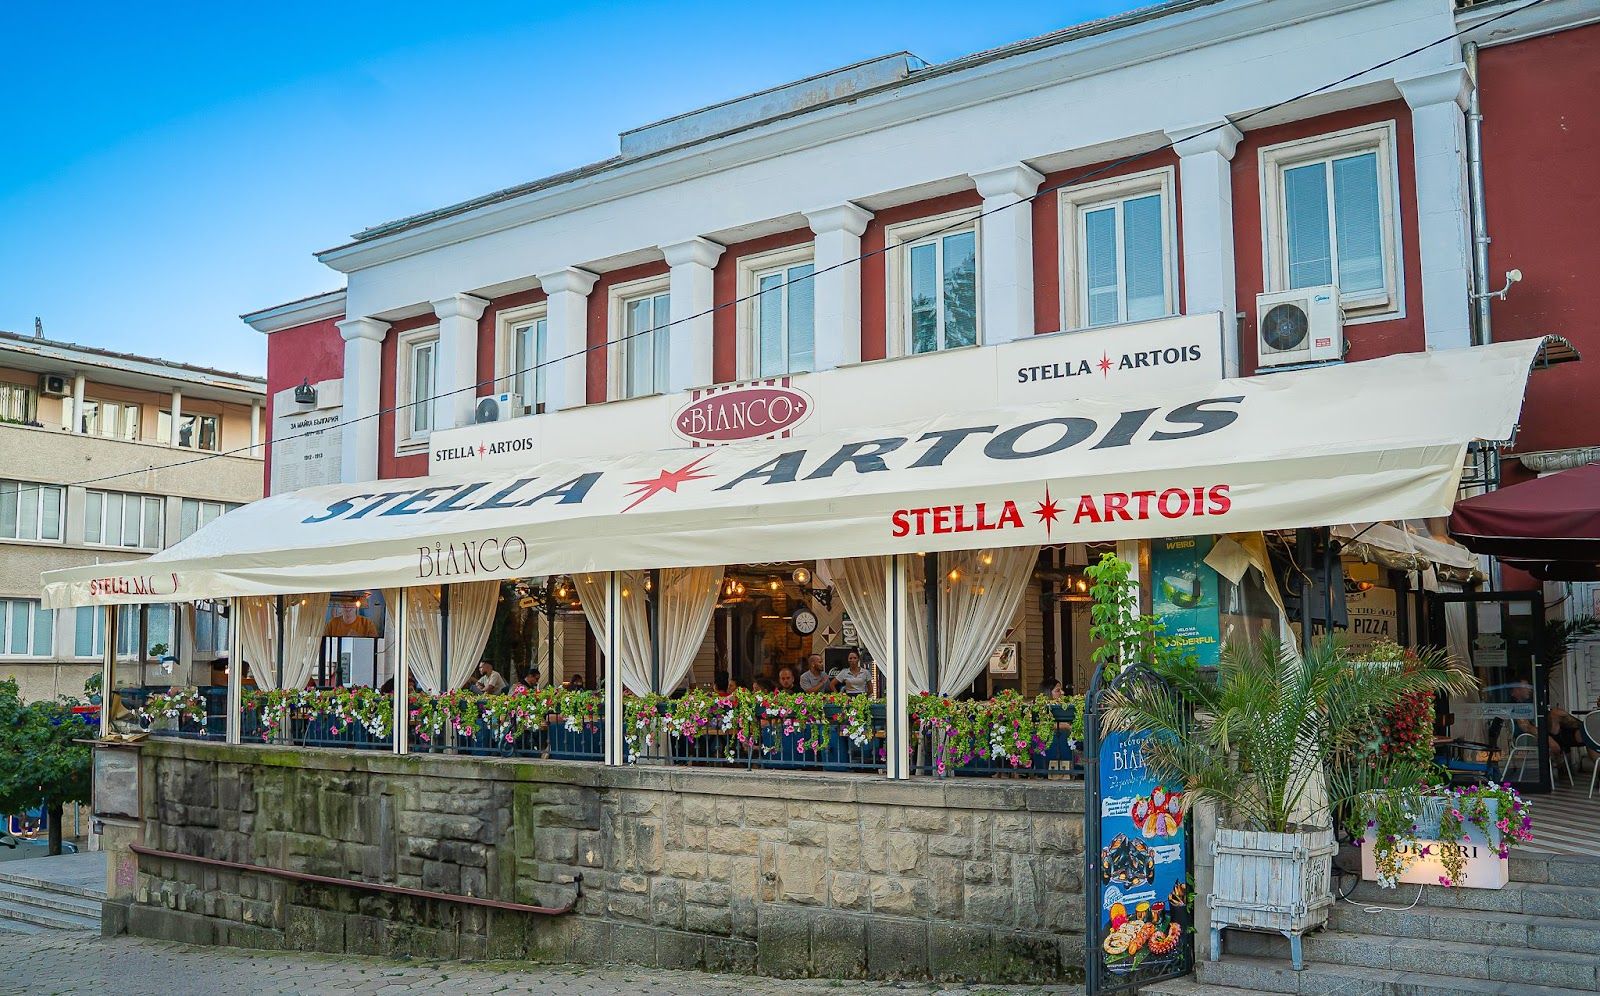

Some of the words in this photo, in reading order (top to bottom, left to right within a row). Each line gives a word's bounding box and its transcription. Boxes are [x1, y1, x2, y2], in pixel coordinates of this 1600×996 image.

[1017, 359, 1092, 383] STELLA
[1117, 345, 1201, 370] ARTOIS
[300, 471, 605, 524] STELLA
[711, 394, 1246, 492] ARTOIS
[435, 446, 475, 462] STELLA
[488, 437, 533, 456] ARTOIS
[891, 500, 1025, 537] STELLA
[1072, 484, 1232, 524] ARTOIS
[1166, 540, 1196, 550] WEIRD
[1354, 618, 1389, 635] PIZZA
[1164, 636, 1217, 648] ONDERFUL
